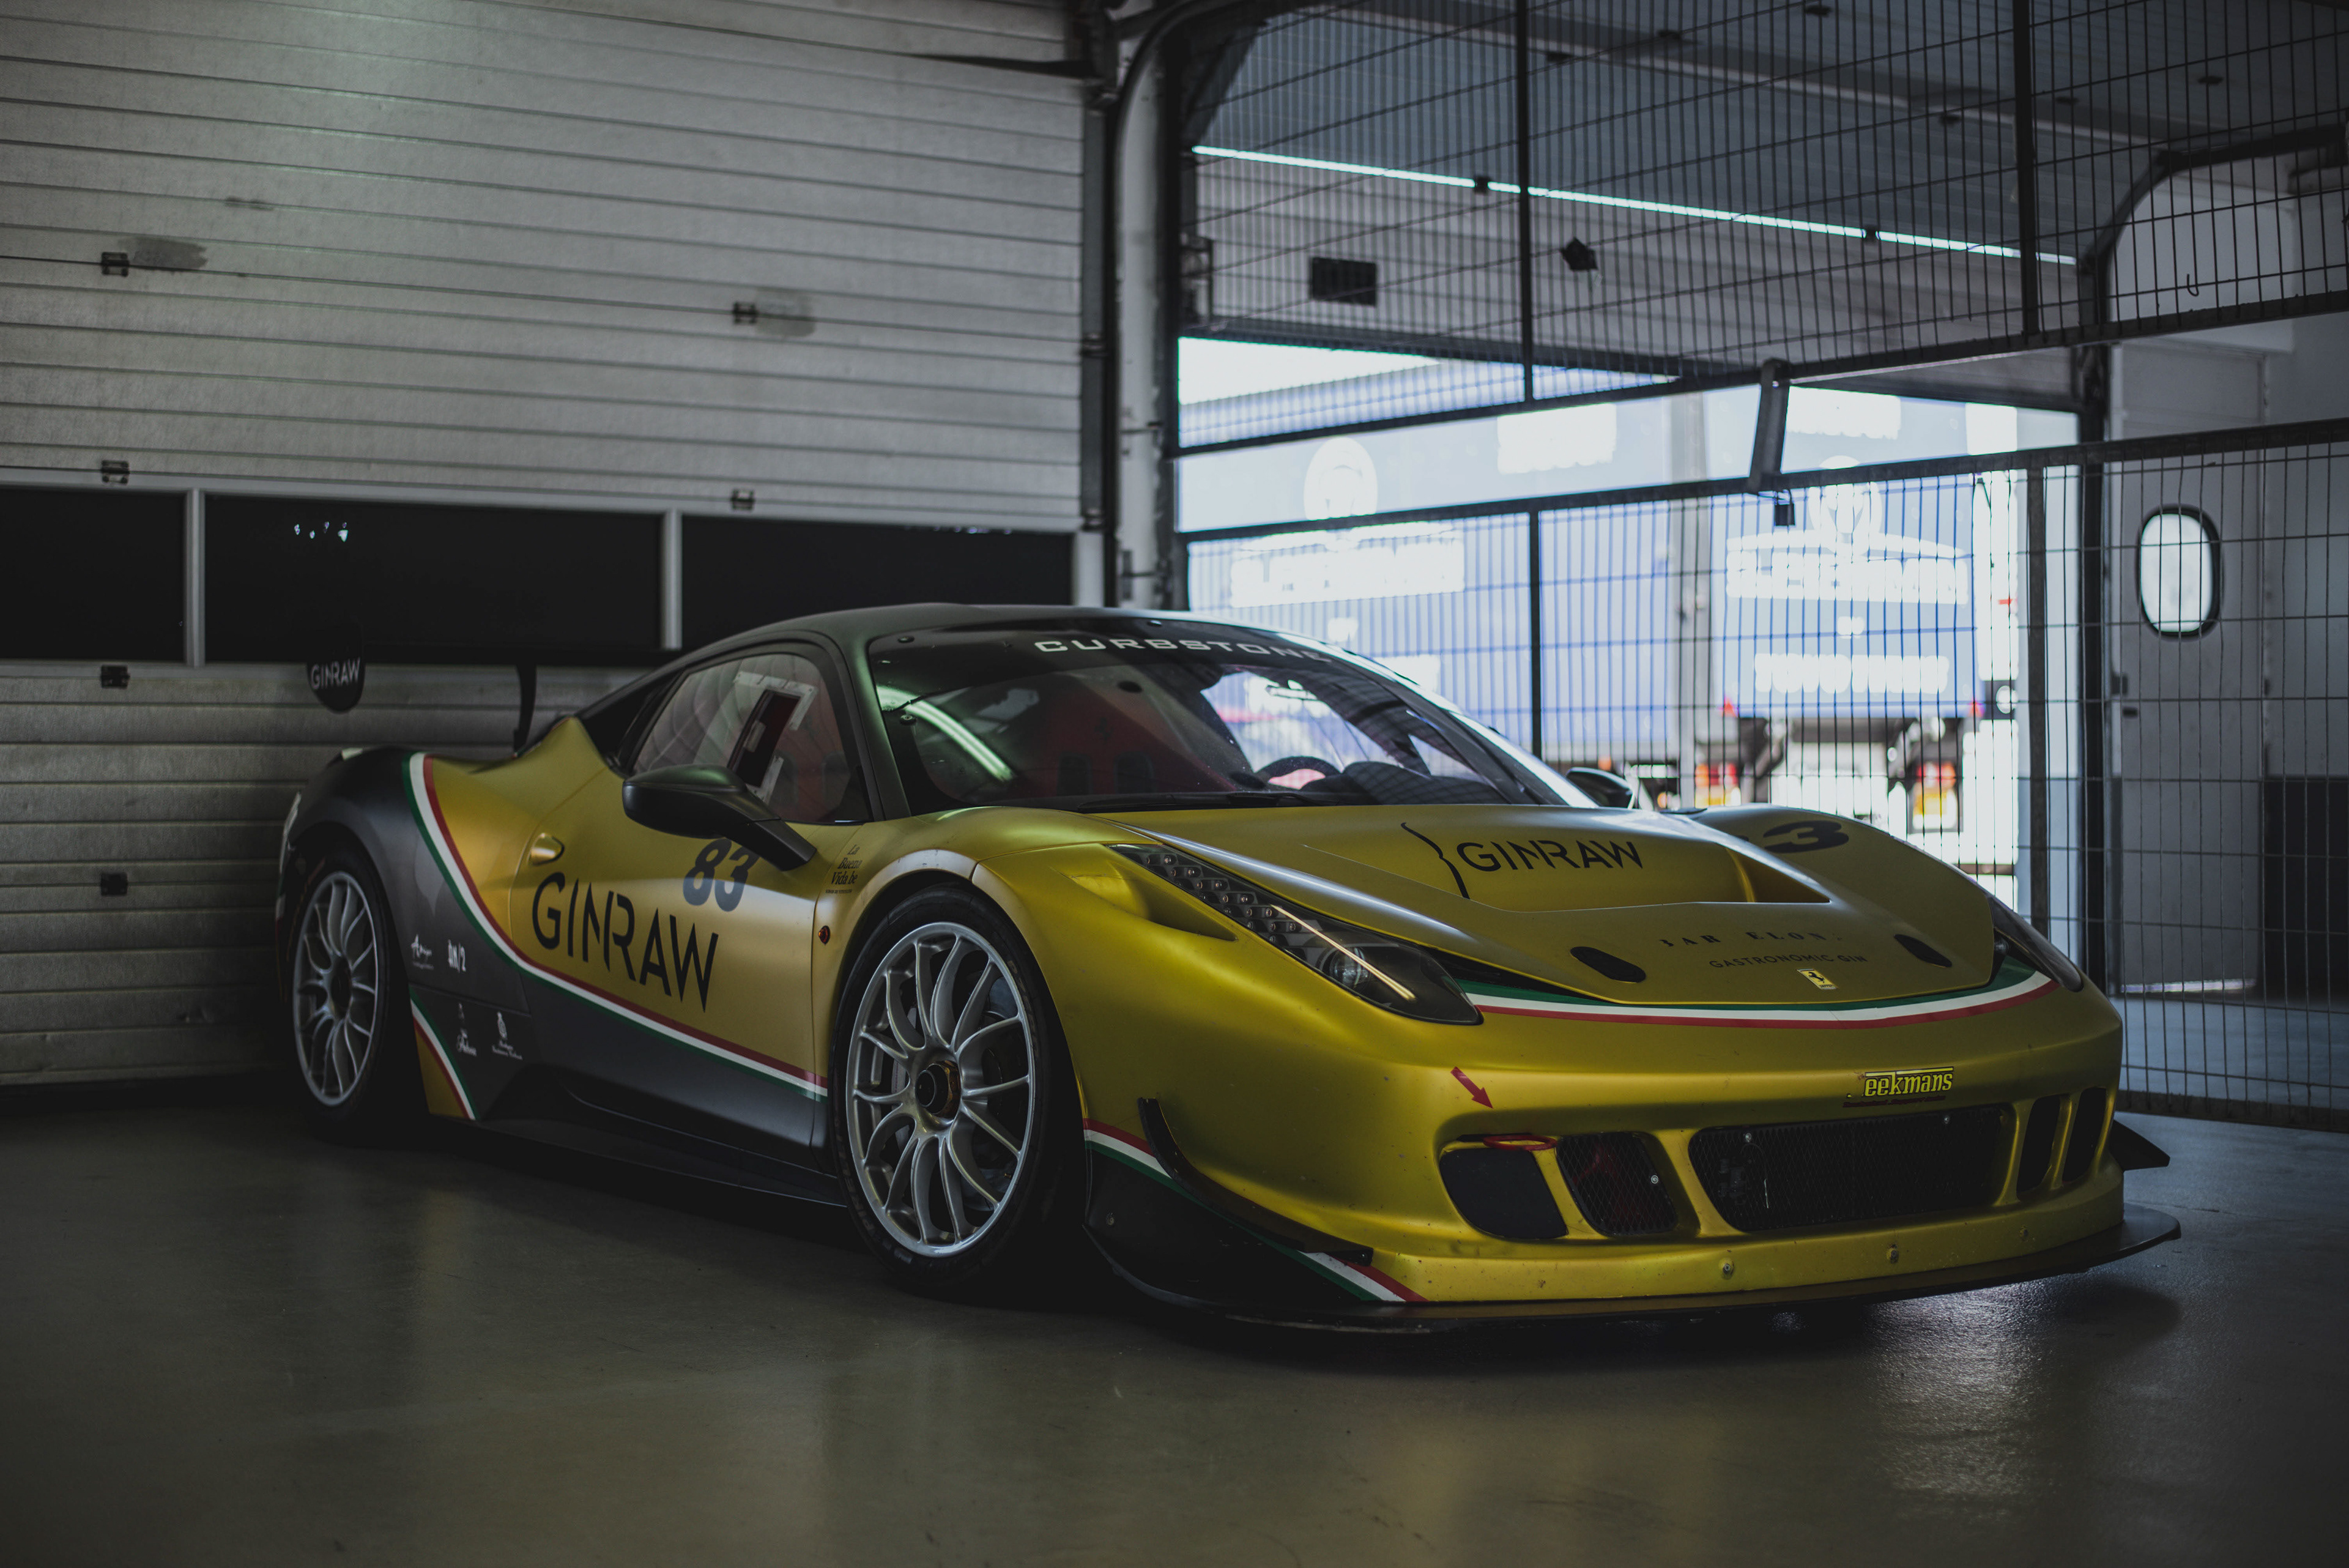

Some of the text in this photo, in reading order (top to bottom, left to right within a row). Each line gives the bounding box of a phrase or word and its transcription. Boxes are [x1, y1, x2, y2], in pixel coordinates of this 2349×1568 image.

[1034, 638, 1332, 663] CURBSTONE
[310, 656, 361, 691] GINRAW
[1736, 820, 1849, 853] 3
[1456, 839, 1643, 872] GINRAW
[683, 837, 761, 912] 83
[532, 872, 719, 1013] GINRAW
[1709, 953, 1869, 968] GASTRONOMIC GIN
[1863, 1066, 1954, 1098] eekmans
